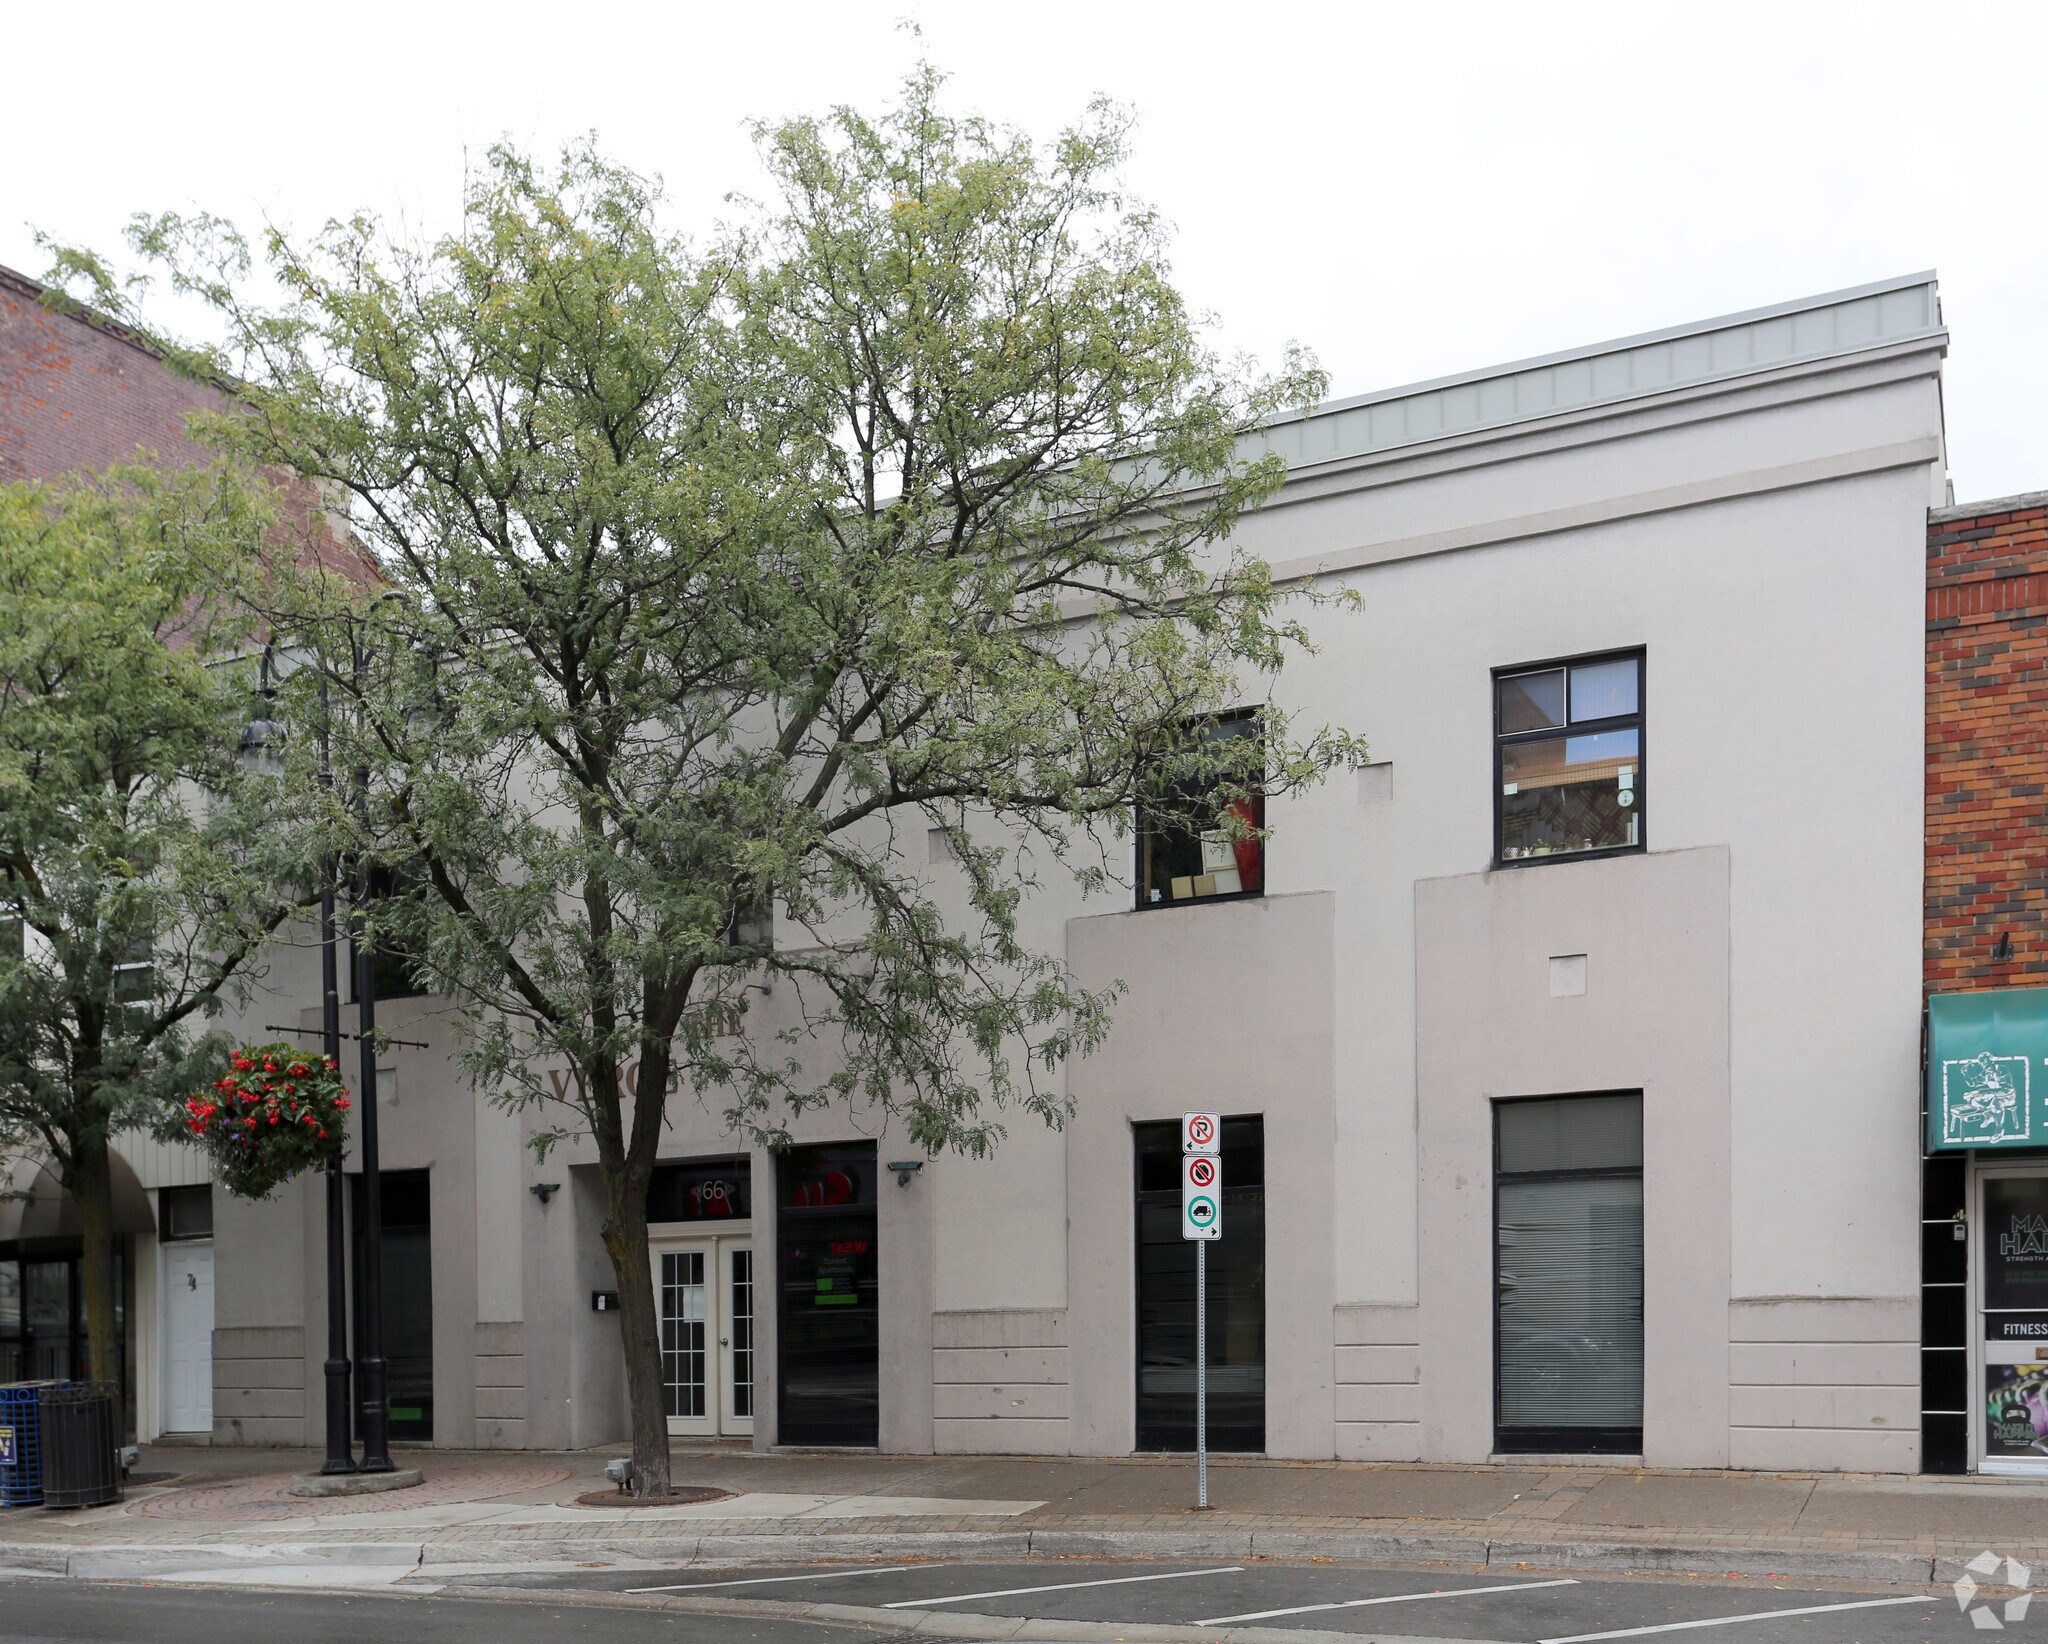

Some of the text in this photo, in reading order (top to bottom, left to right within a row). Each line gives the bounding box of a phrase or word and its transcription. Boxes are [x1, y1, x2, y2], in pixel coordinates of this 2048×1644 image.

[703, 1180, 724, 1200] 66
[187, 1273, 196, 1292] 74
[2004, 1323, 2048, 1335] FITNESS
